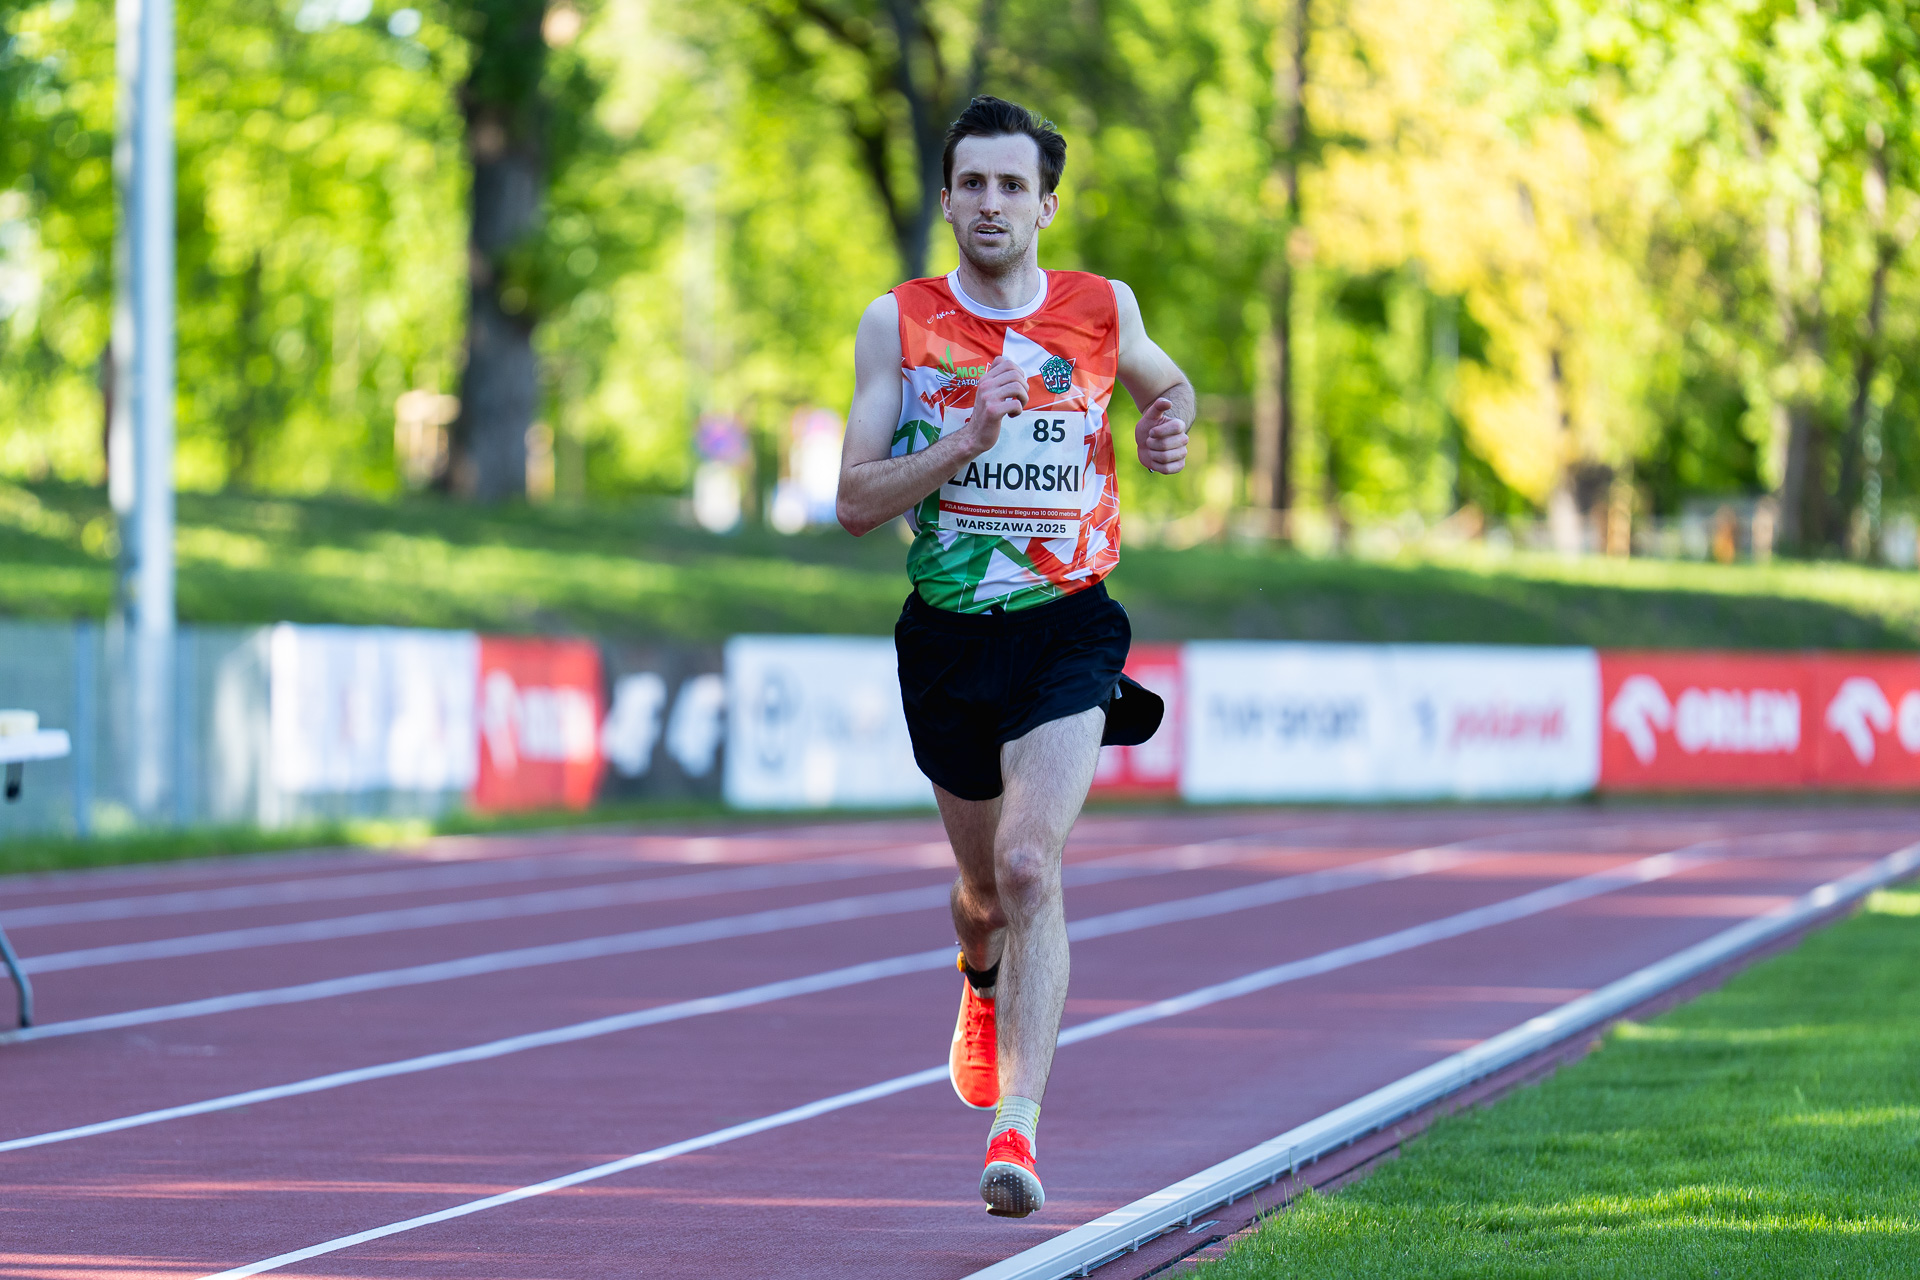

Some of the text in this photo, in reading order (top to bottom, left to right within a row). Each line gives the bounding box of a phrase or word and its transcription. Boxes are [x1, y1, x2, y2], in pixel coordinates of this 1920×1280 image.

[956, 365, 986, 378] MOS
[1032, 418, 1066, 443] 85
[958, 504, 990, 514] Mistrzostwa
[1014, 509, 1031, 517] Biegu
[955, 517, 1067, 534] WARSZAWA 2025
[1674, 686, 1801, 754] ORLEN
